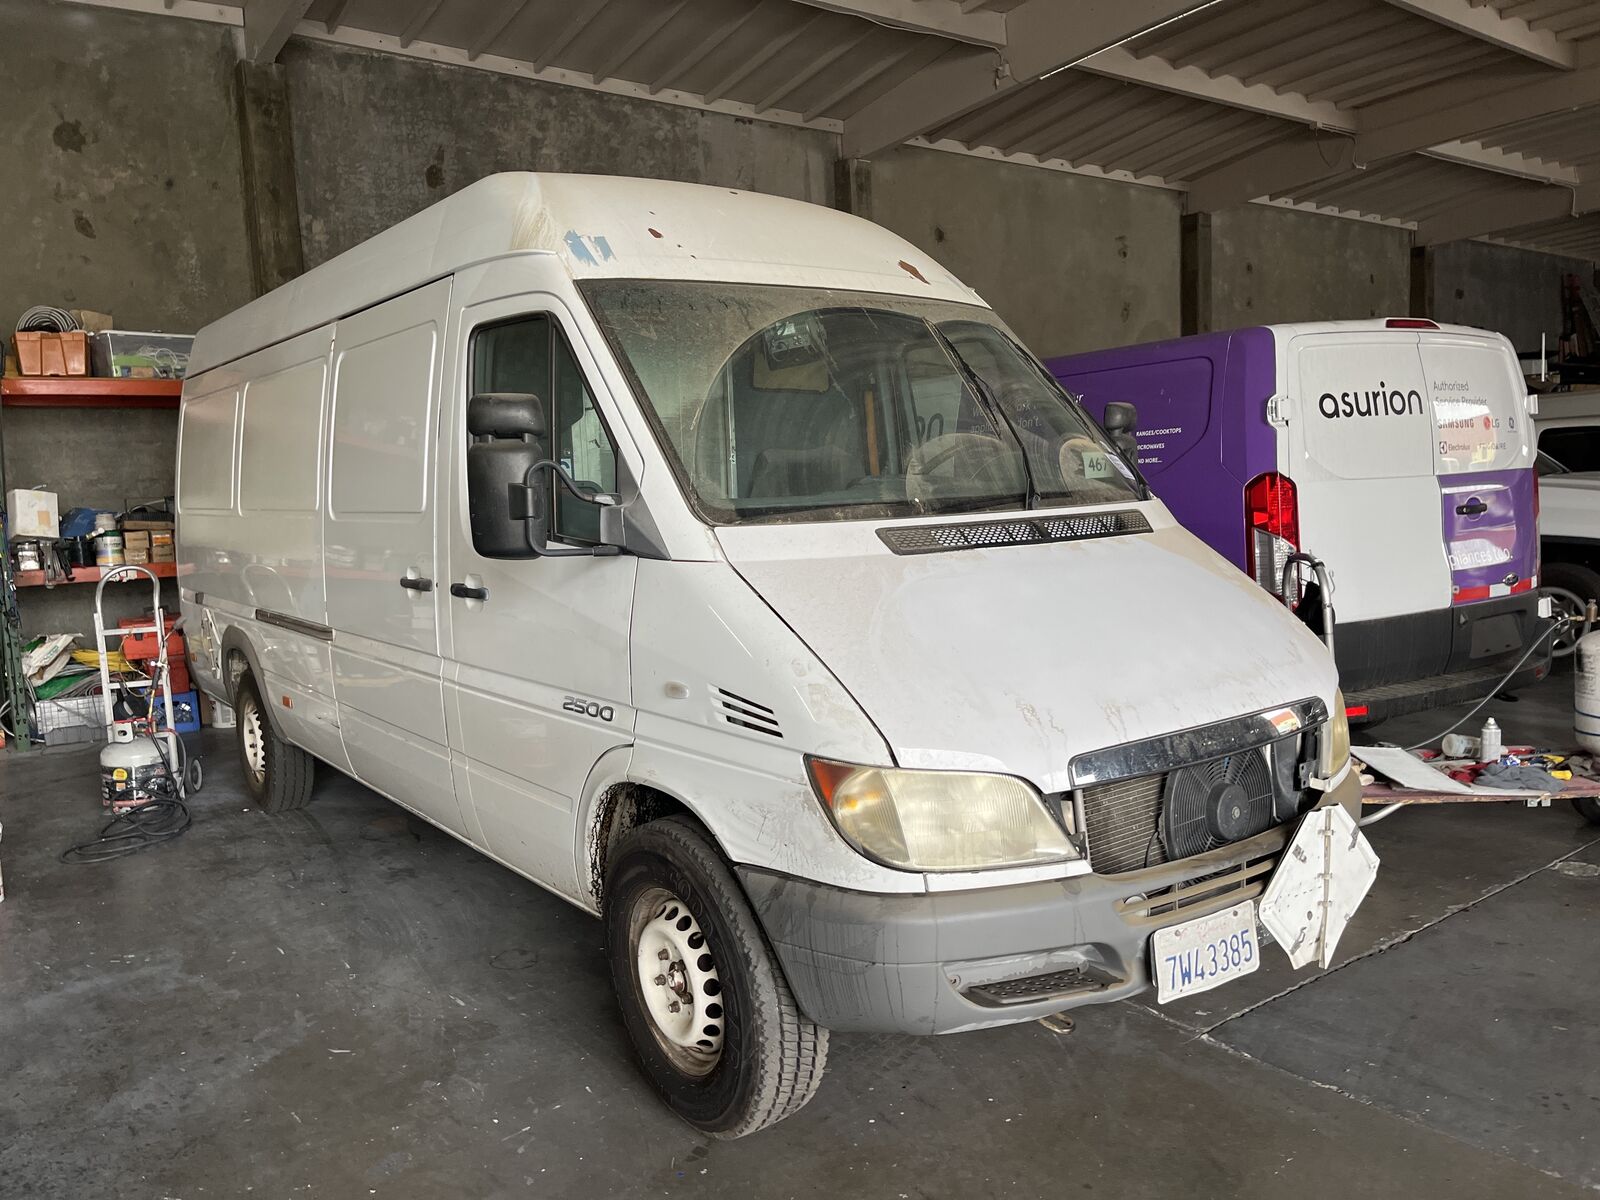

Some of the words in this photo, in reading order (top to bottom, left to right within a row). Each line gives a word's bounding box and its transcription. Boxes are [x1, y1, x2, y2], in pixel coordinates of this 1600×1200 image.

[1433, 380, 1469, 391] Authorized
[1318, 381, 1423, 419] asurion
[1136, 427, 1182, 437] RANGES/COOKTOPS
[1438, 418, 1475, 429] SAMSUNG
[562, 695, 614, 722] 2500
[1165, 929, 1253, 990] 7W43385
